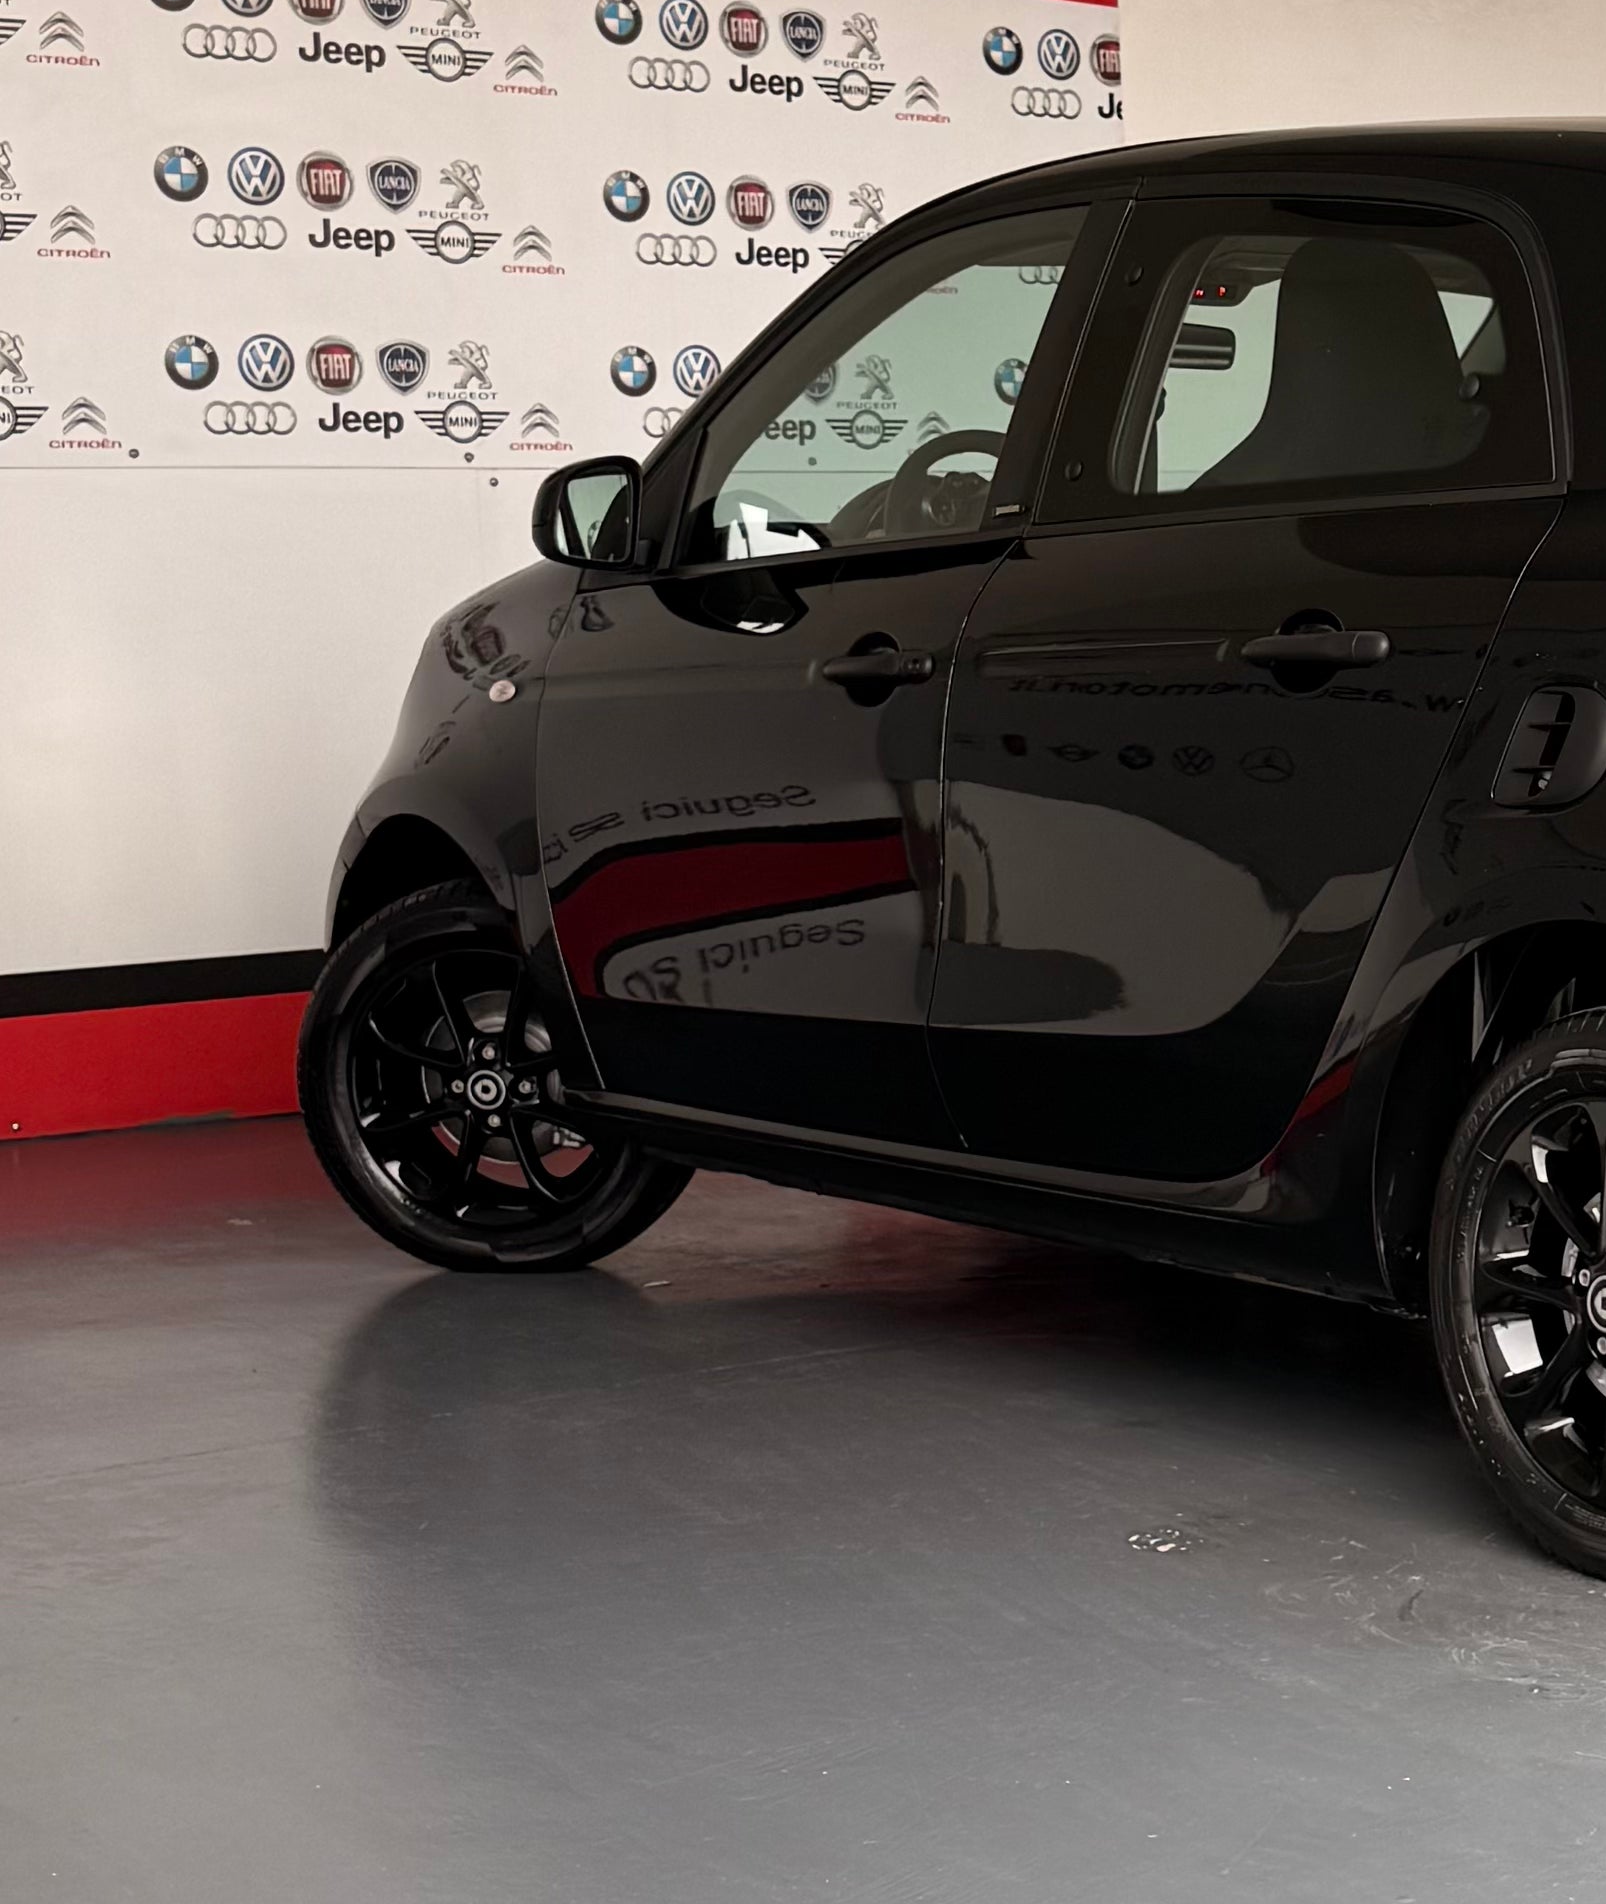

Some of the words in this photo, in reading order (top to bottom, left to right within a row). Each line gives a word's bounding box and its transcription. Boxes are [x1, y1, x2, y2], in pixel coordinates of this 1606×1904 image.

[409, 26, 482, 40] PEUGEOT
[731, 17, 760, 45] FIAT
[298, 31, 387, 73] Jeep
[431, 54, 461, 67] MINI
[728, 64, 805, 103] Jeep
[310, 168, 343, 196] FIAT
[418, 210, 490, 222] PEUGEOT
[738, 191, 764, 217] FIAT
[308, 218, 396, 258] Jeep
[440, 236, 470, 249] MINI
[735, 237, 810, 273] Jeep
[320, 354, 351, 380] FIAT
[427, 391, 499, 401] PEUGEOT
[318, 402, 405, 440] Jeep
[448, 416, 478, 429] MINI
[764, 419, 817, 446] eep
